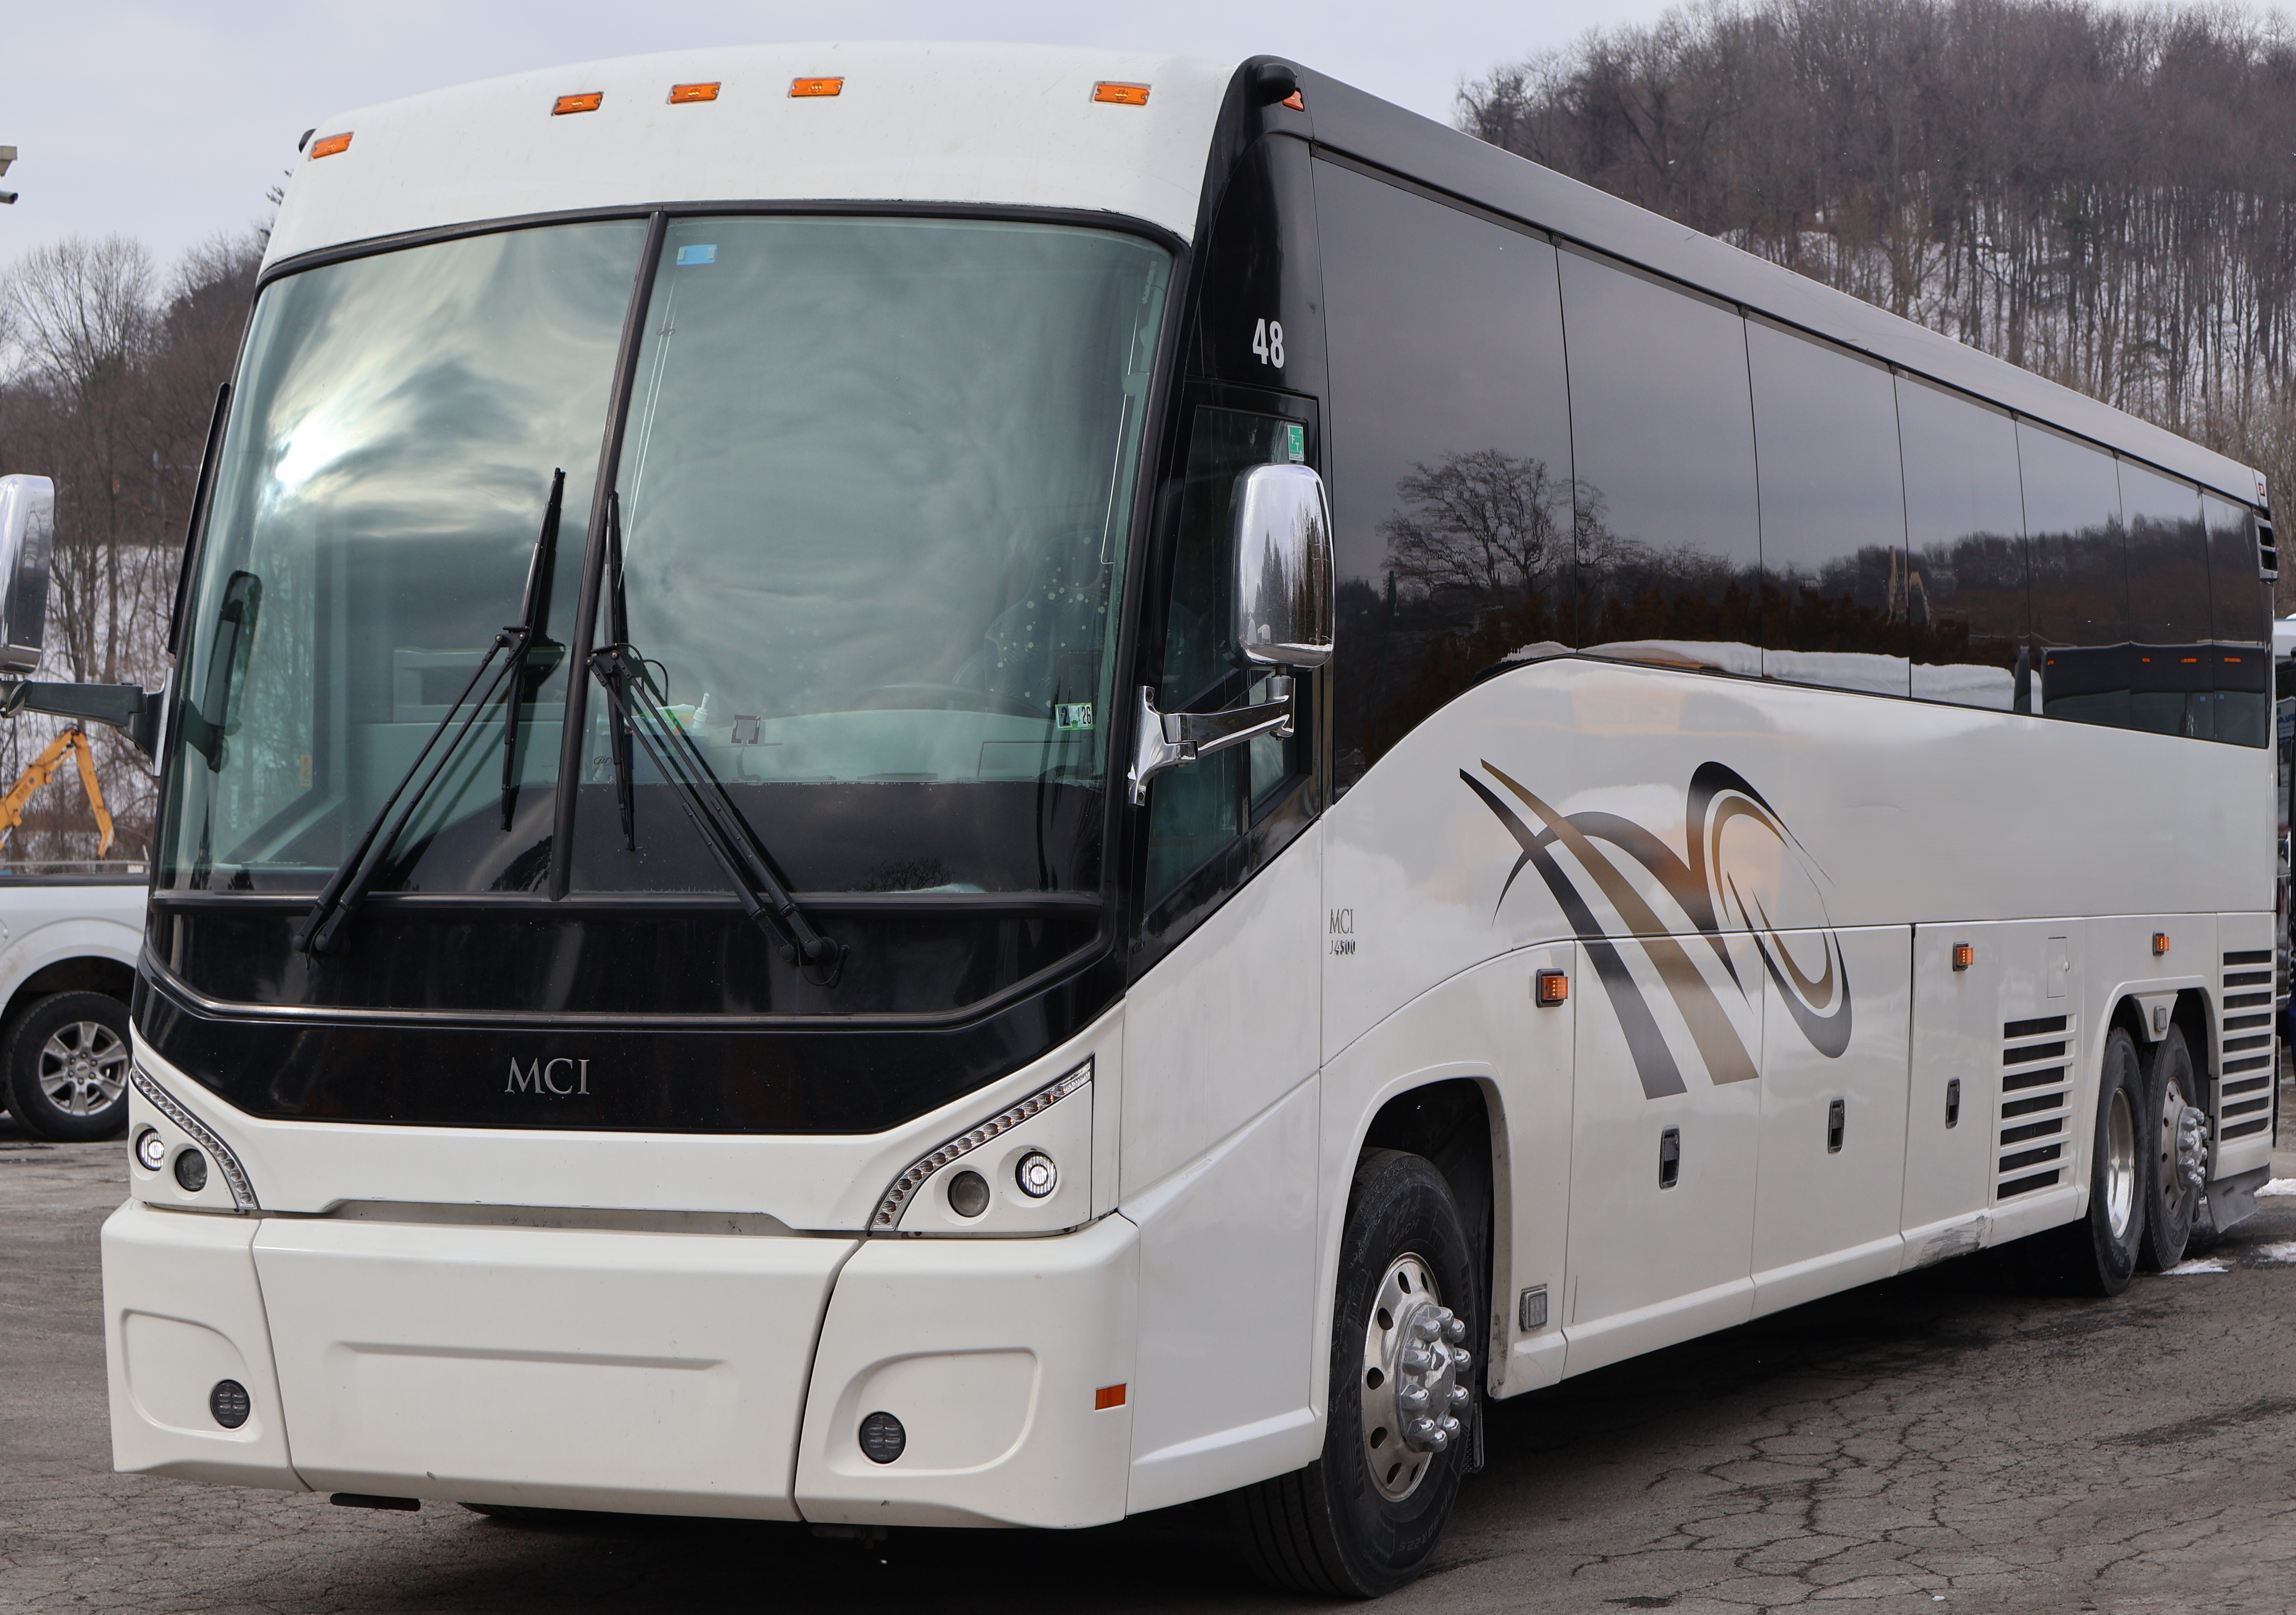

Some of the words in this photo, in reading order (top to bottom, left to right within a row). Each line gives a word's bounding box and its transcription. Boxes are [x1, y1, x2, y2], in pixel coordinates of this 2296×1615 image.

[1252, 318, 1285, 369] 48
[1061, 707, 1069, 726] 2
[1082, 706, 1091, 724] 26
[1329, 908, 1354, 934] MCI
[1329, 939, 1357, 956] J4500
[504, 1057, 590, 1095] MCI
